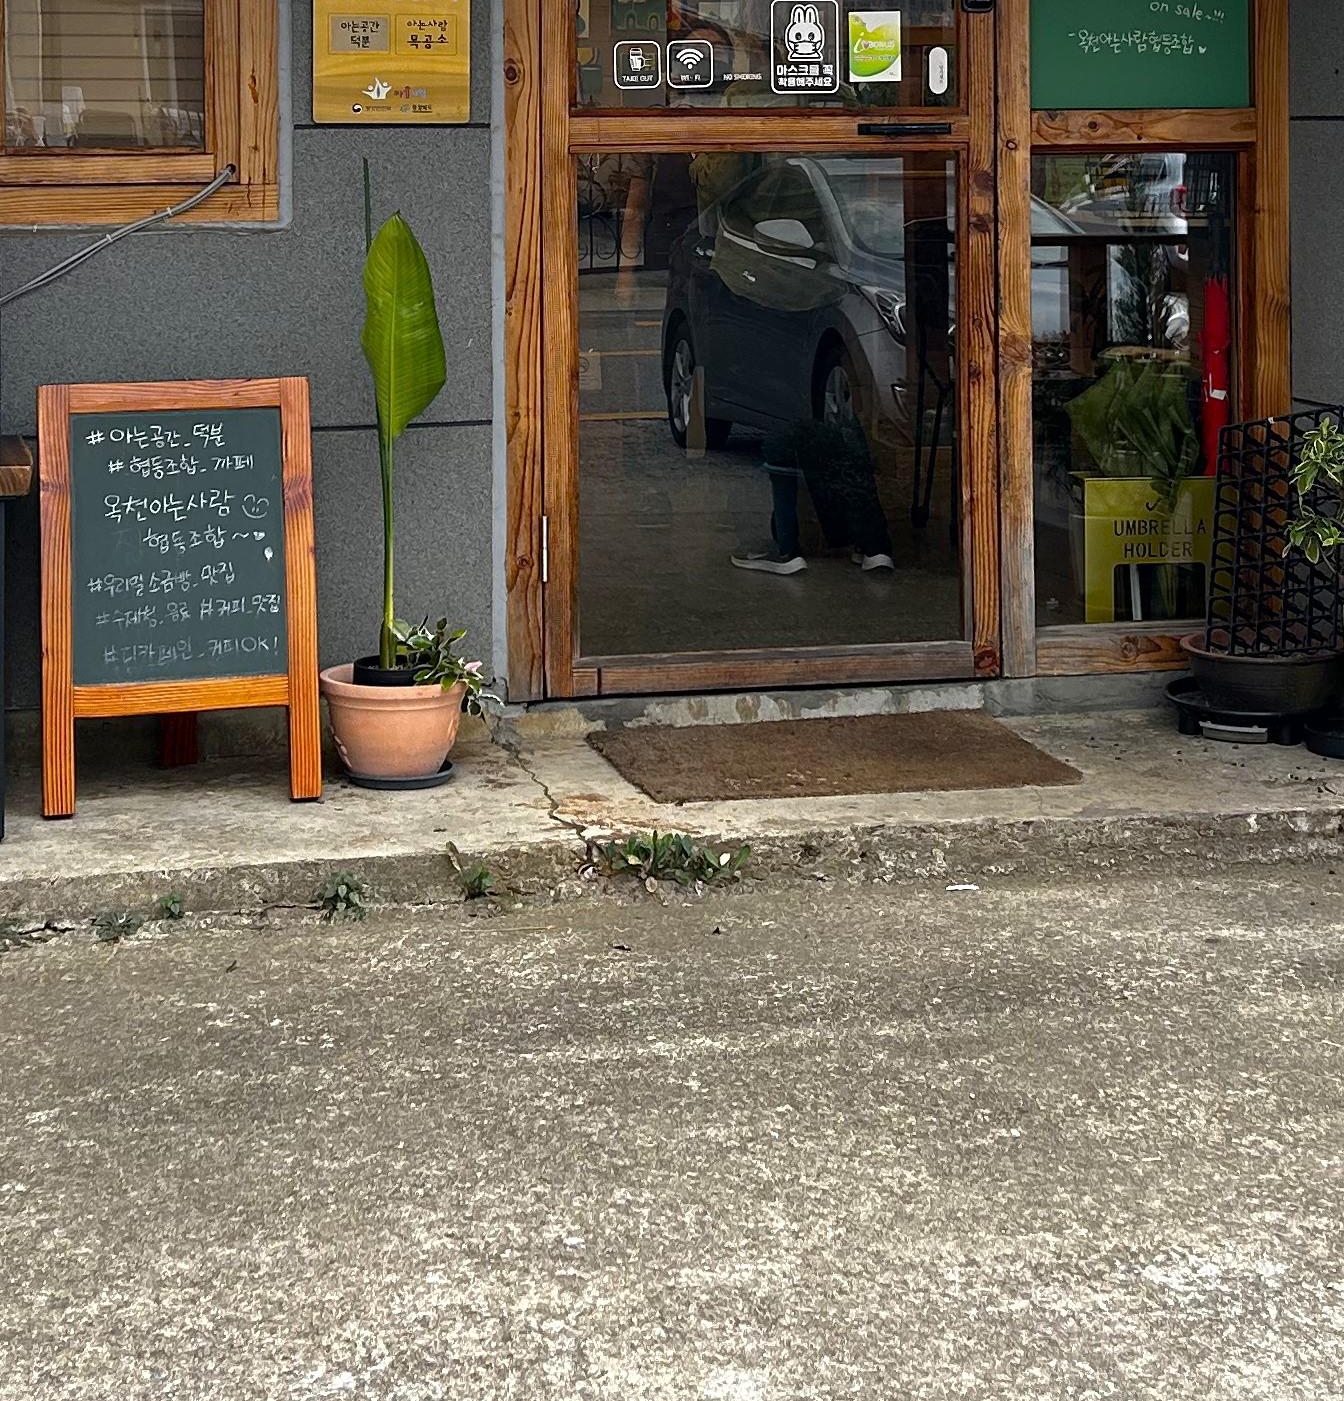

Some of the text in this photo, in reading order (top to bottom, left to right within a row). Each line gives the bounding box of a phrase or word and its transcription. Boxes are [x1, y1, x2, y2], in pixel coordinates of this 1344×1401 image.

[1149, 1, 1169, 13] on
[340, 21, 380, 33] 아는공간
[406, 19, 448, 33] 아는사람
[350, 35, 371, 49] 덕분
[406, 34, 449, 50] 목공소
[776, 64, 820, 76] 마스크를
[777, 77, 833, 87] 착용해주세요
[104, 489, 235, 522] 옥천아는사람
[1113, 519, 1206, 537] UMBRELLA
[1124, 541, 1193, 559] HOLDER
